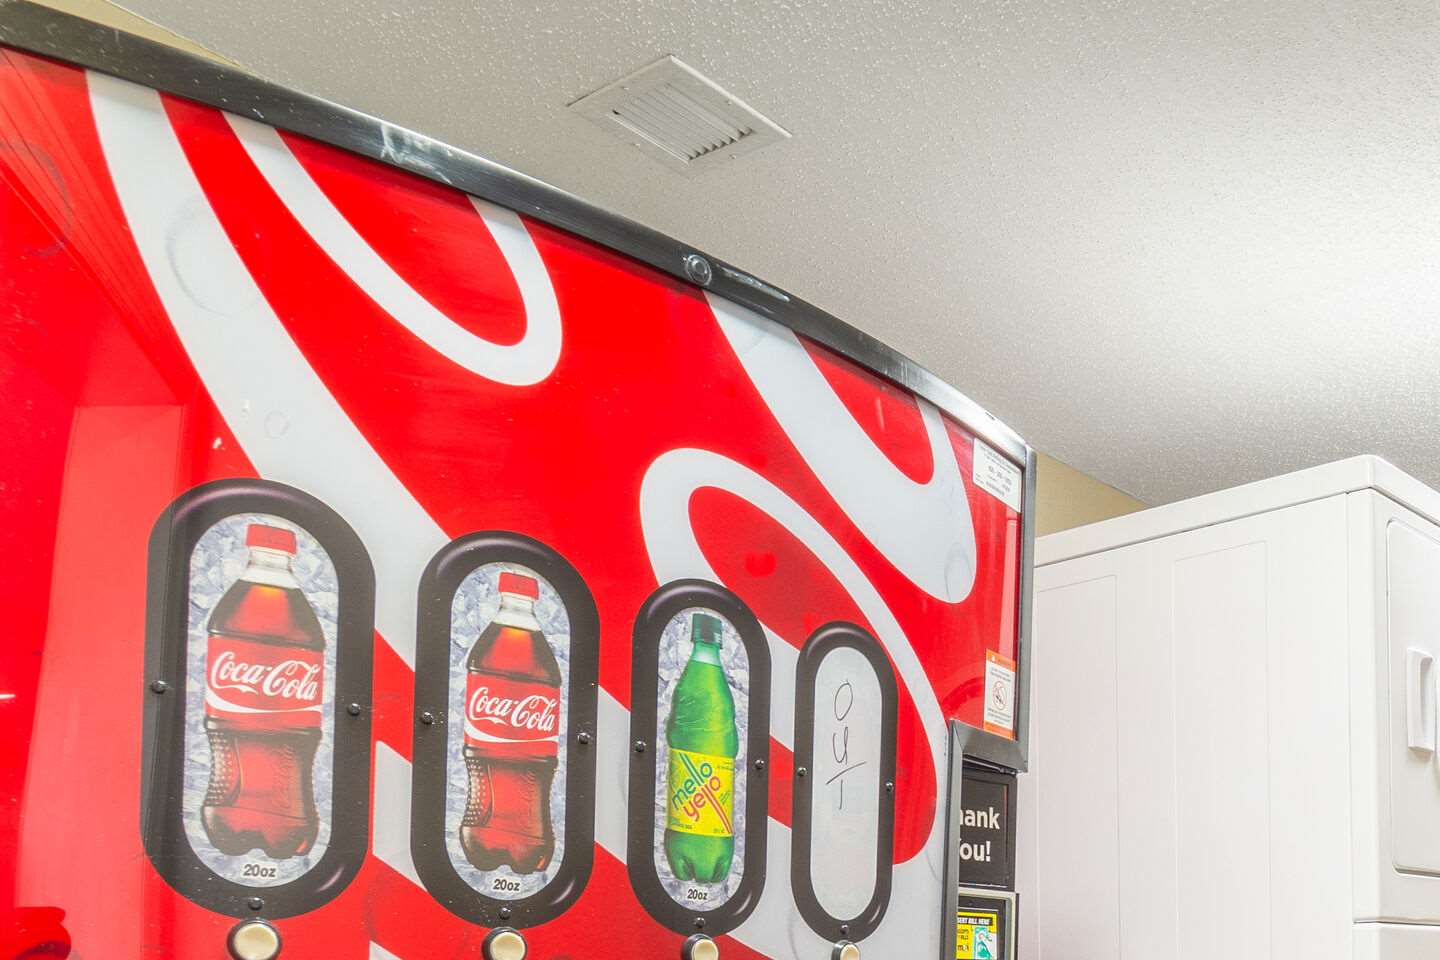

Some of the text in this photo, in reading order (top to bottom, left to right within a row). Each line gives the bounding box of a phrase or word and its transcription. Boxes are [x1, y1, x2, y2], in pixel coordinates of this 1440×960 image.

[211, 651, 320, 700] Coca-Cola
[469, 686, 557, 731] Coca-Cola
[671, 752, 713, 810] mello
[683, 776, 734, 833] yello
[960, 806, 1001, 830] ank
[959, 838, 991, 862] ou!
[243, 863, 277, 879] 20oz
[493, 878, 521, 892] 20oz
[687, 888, 708, 901] 20oz
